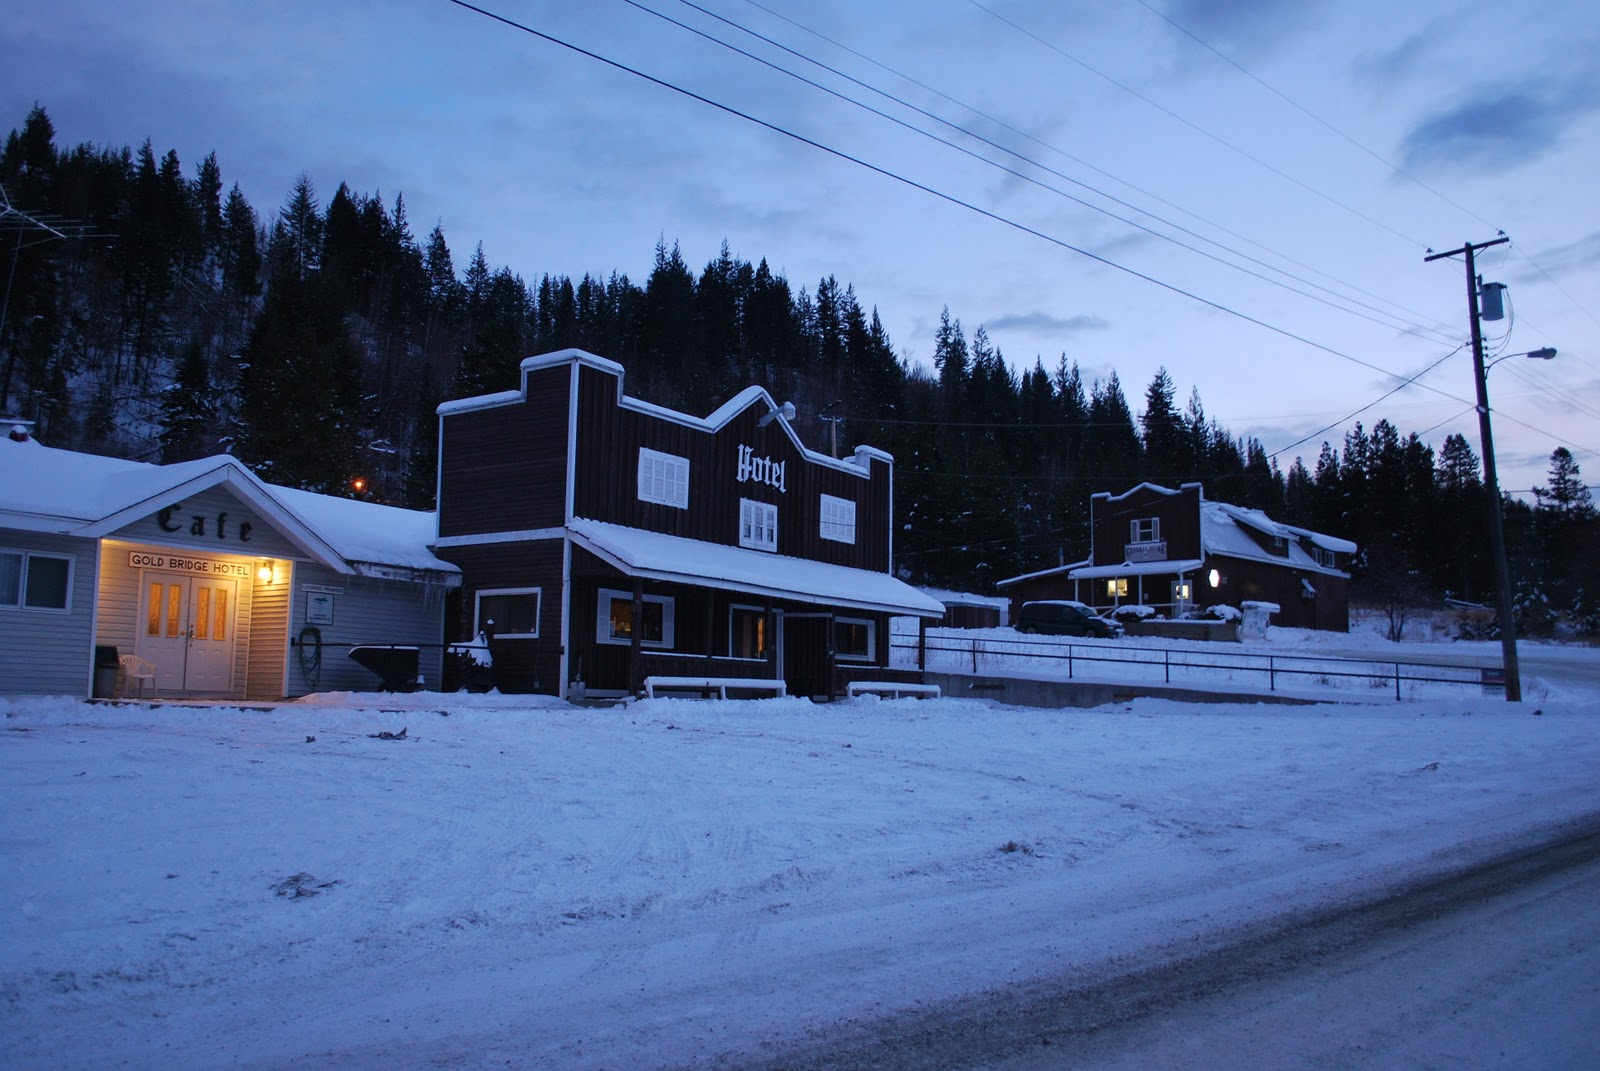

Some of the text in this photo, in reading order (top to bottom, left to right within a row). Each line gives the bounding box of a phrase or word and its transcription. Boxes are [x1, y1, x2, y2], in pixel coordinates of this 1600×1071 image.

[736, 443, 786, 493] Hotel
[158, 504, 252, 542] Cafe
[132, 554, 249, 576] GOLD BRIDGE HOTEL
